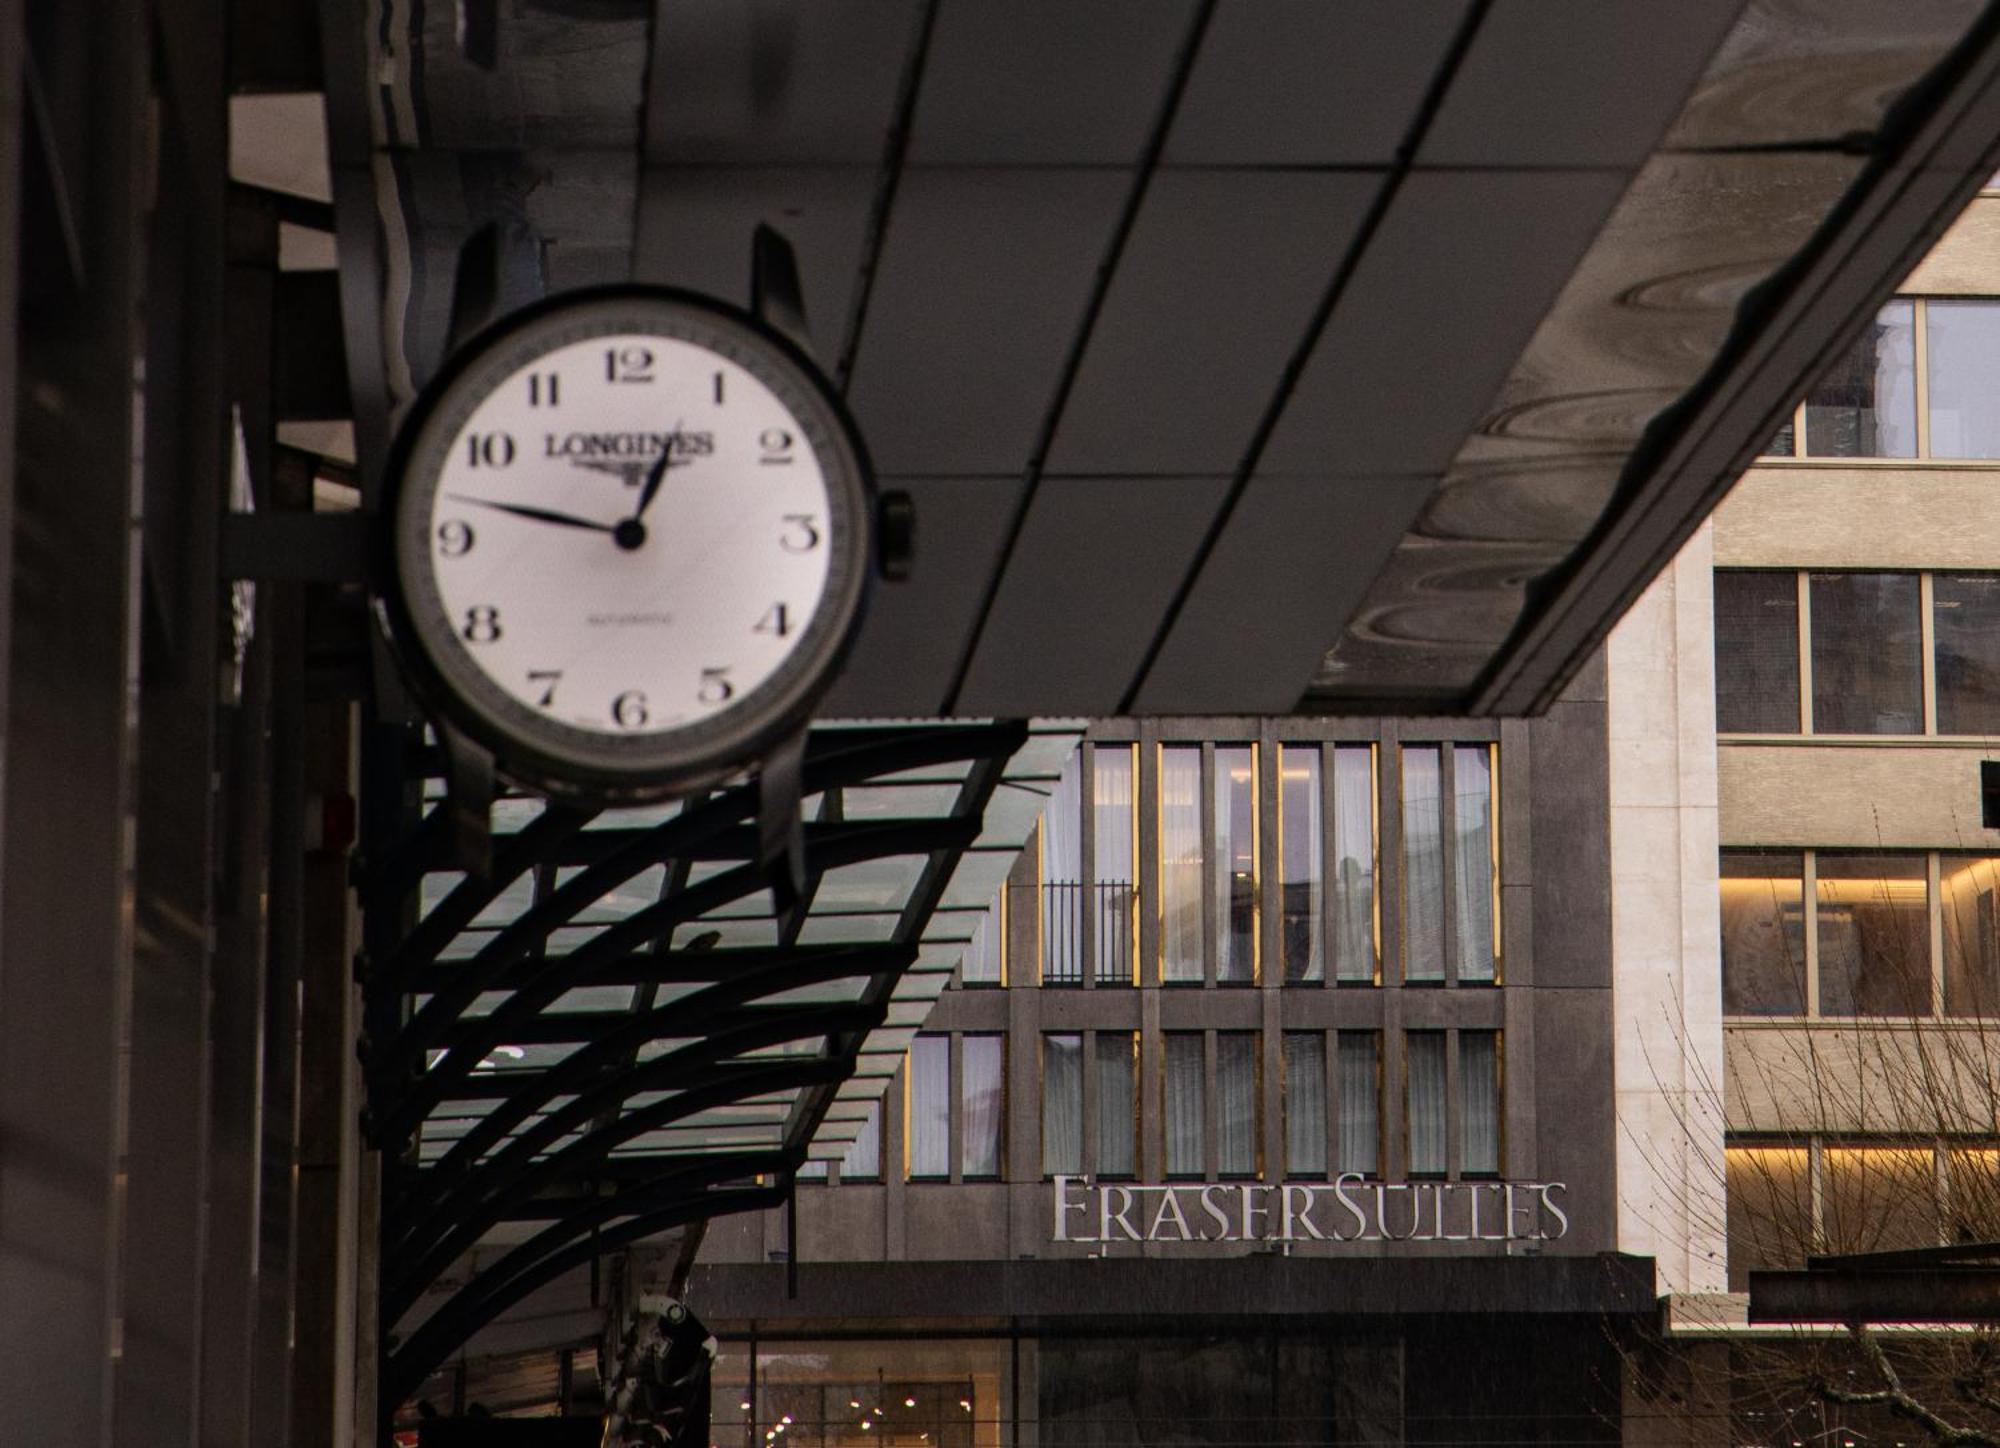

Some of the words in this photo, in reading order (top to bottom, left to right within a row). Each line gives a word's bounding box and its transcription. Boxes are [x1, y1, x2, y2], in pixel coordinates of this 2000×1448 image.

[606, 348, 655, 384] 12
[528, 373, 560, 406] 11
[713, 371, 725, 406] 1
[467, 432, 516, 468] 10
[545, 432, 714, 457] LONGINES
[760, 428, 794, 466] 2
[438, 519, 475, 558] 9
[779, 513, 820, 553] 3
[463, 605, 502, 645] 8
[753, 601, 791, 638] 4
[526, 668, 563, 707] 7
[699, 665, 735, 704] 5
[611, 690, 649, 729] 6
